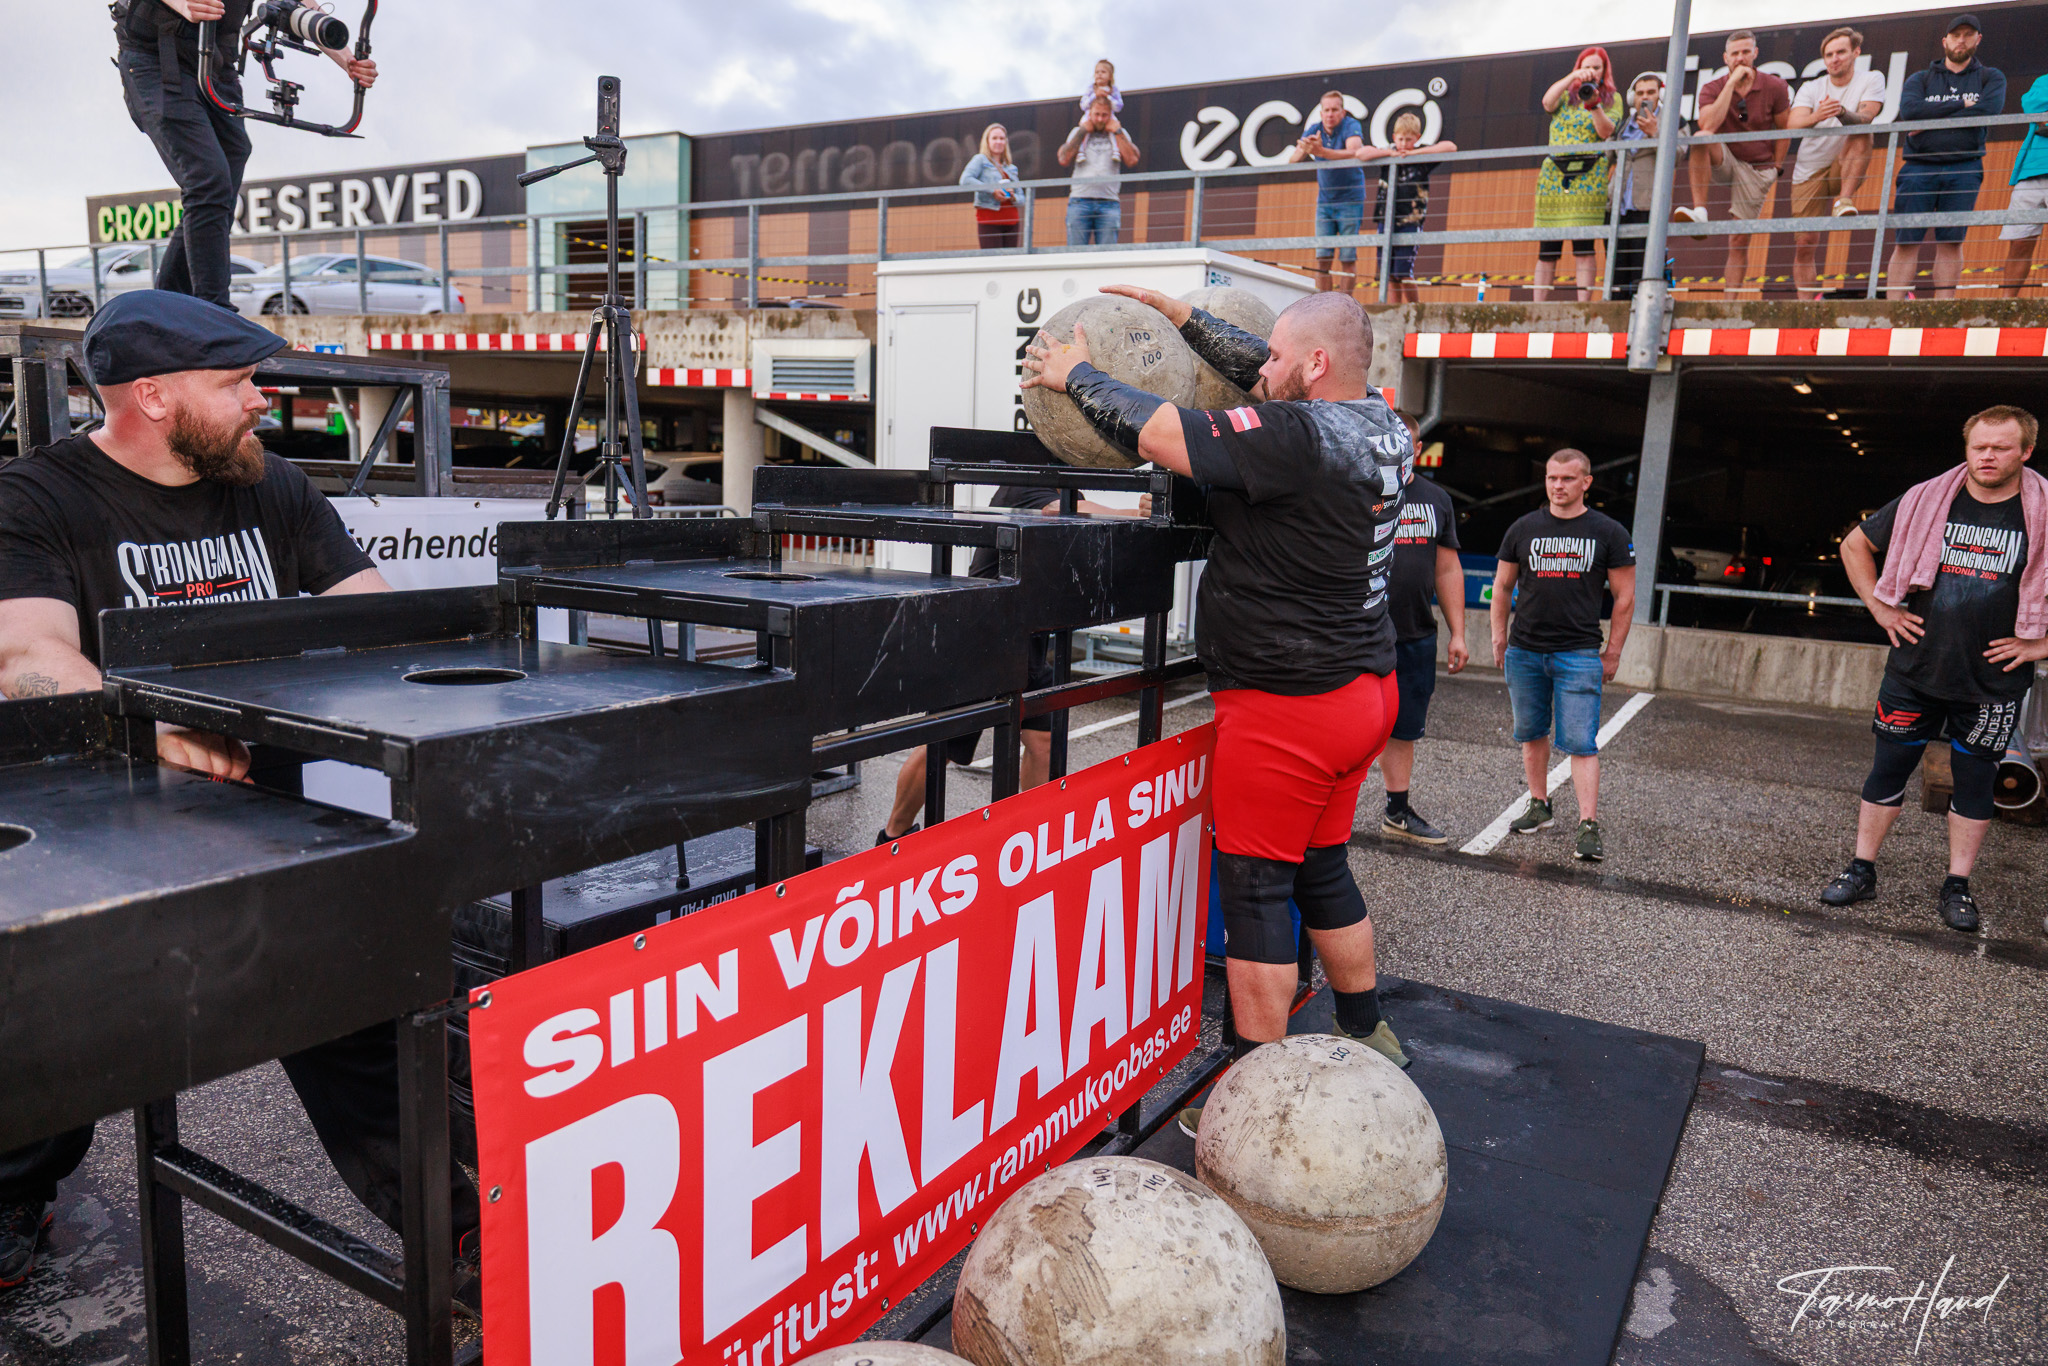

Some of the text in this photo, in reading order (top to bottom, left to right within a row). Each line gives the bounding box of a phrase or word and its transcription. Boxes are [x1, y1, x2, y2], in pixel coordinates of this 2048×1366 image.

[1129, 332, 1151, 343] 100
[1142, 350, 1162, 367] 100
[349, 526, 498, 560] vahende
[1394, 537, 1413, 545] TONIA
[1529, 537, 1596, 563] STRONGMAN
[1969, 545, 1984, 554] PRO
[117, 526, 279, 606] STRONGMAN
[1942, 564, 1998, 581] ESTONIA 2026
[186, 581, 213, 598] PRO
[1992, 700, 2017, 752] ATCHES
[523, 754, 1207, 1099] SIIN VÕIKS OLLA SINU
[1329, 1046, 1351, 1062] 120
[525, 812, 1203, 1366] REKLAAM
[892, 1003, 1192, 1268] www.rammukoobas.ee
[1092, 1168, 1112, 1188] 140
[1142, 1174, 1167, 1192] 140
